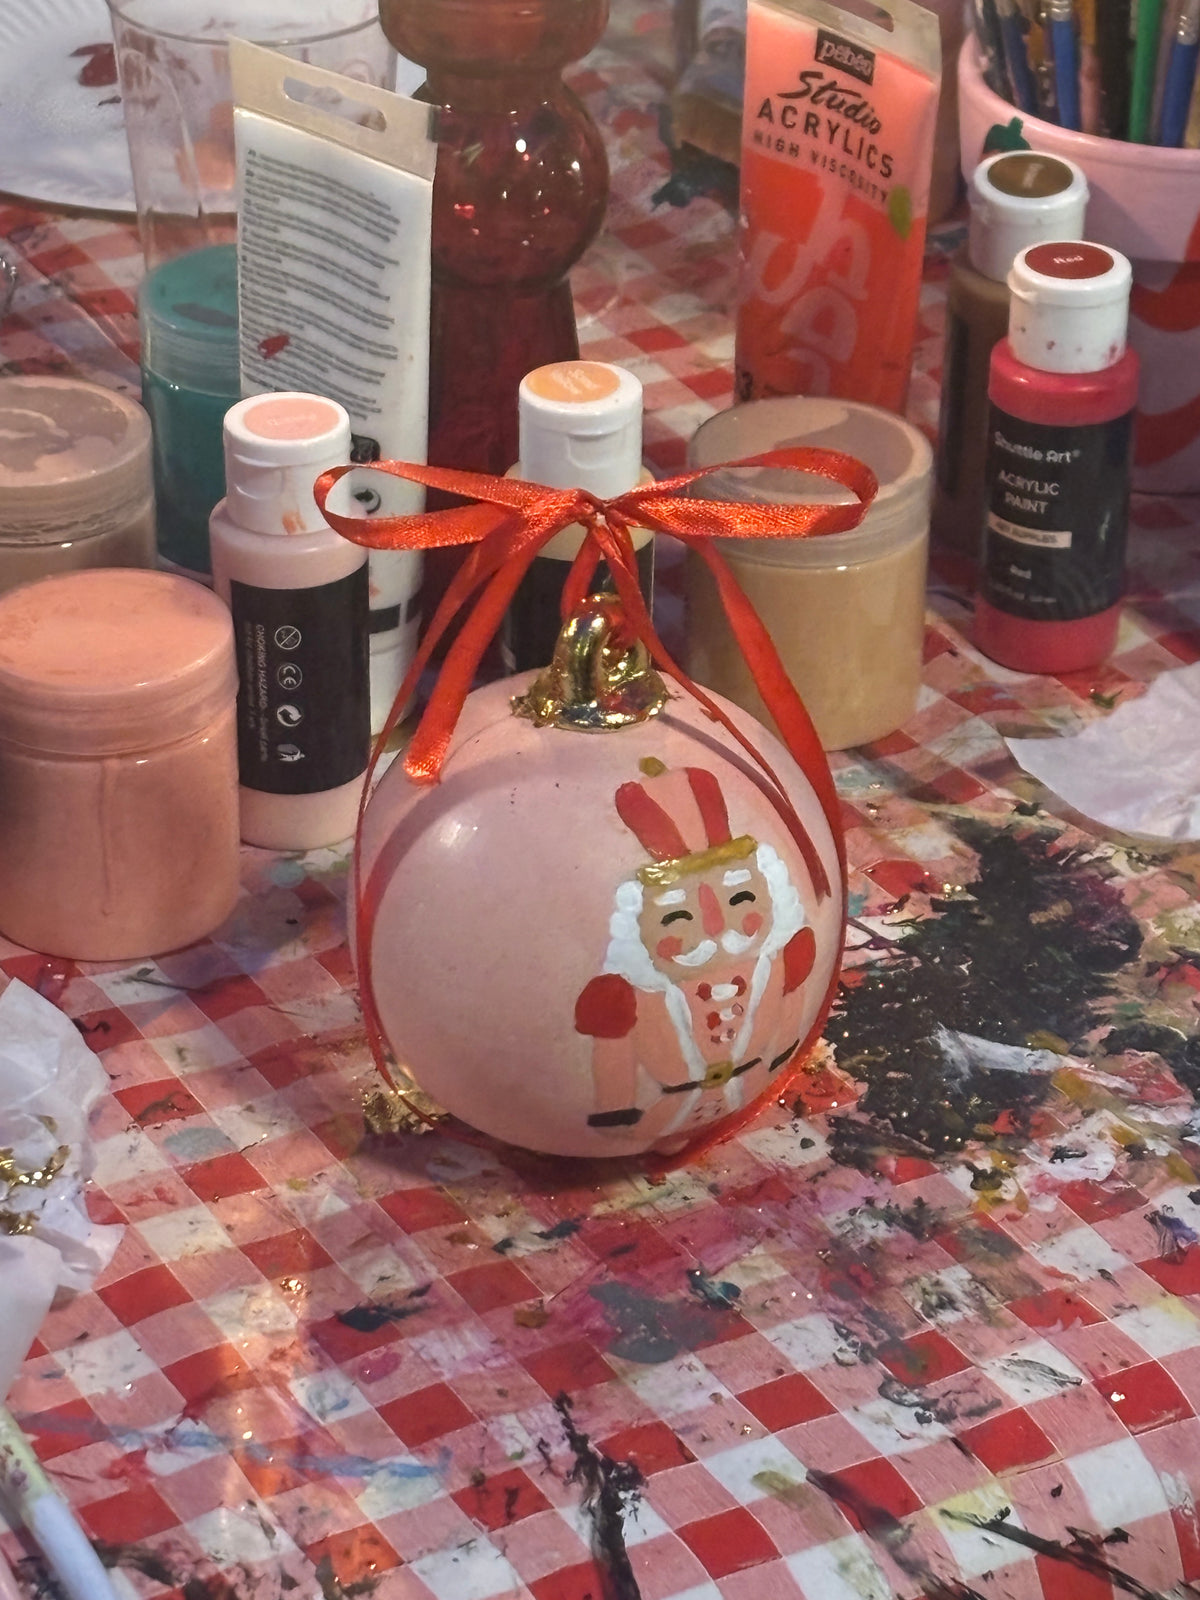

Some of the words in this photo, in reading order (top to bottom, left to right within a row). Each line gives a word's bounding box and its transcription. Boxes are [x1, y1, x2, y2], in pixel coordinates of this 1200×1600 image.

[777, 70, 882, 135] Studio
[757, 97, 894, 178] ACRYLICS
[754, 129, 799, 158] HIGH
[811, 150, 889, 203] VISCOSITY
[1053, 255, 1084, 265] Red
[998, 470, 1060, 496] ACRYLIC
[1005, 491, 1049, 514] PAINT
